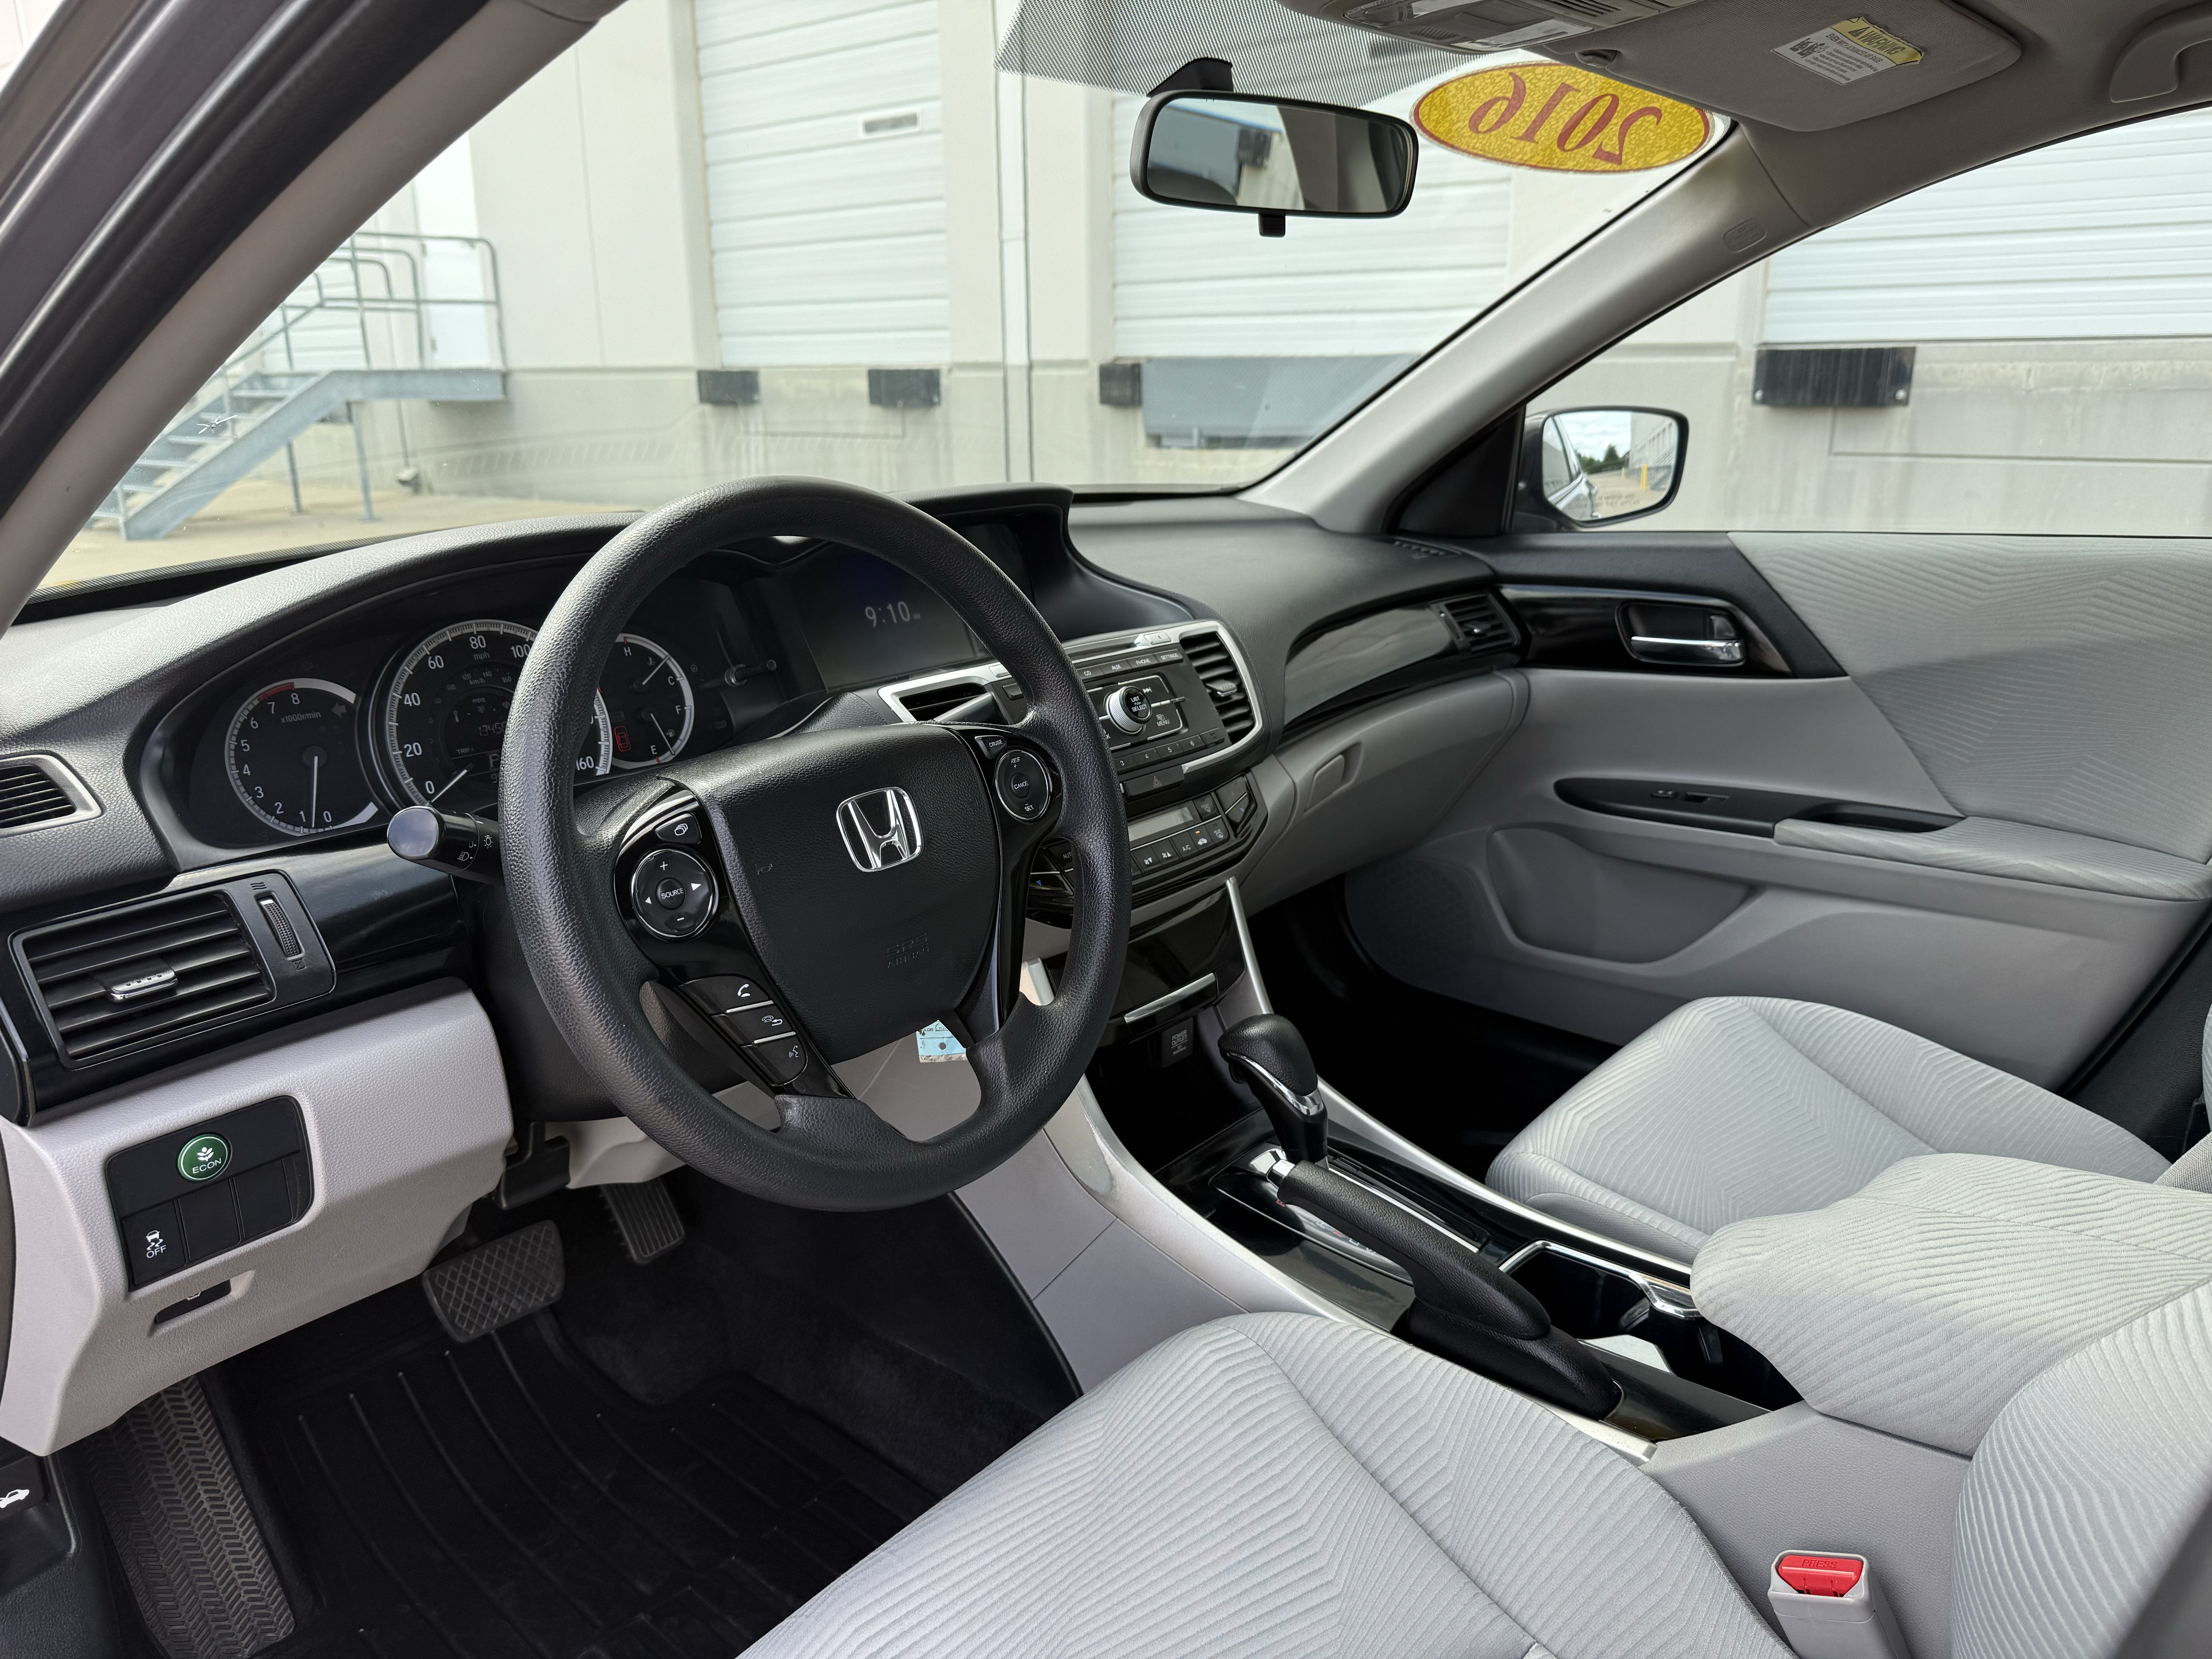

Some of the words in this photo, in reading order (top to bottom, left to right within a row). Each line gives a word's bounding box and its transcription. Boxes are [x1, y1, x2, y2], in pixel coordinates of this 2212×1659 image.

[1858, 31, 1906, 55] WARNING
[865, 601, 910, 627] 9:10
[469, 635, 486, 649] 80
[473, 651, 490, 660] mph
[511, 644, 531, 658] 100
[624, 647, 632, 656] H
[428, 655, 444, 670] 60
[668, 676, 675, 685] C
[291, 692, 300, 704] 8
[404, 692, 421, 706] 40
[267, 702, 275, 714] 7
[675, 705, 681, 714] F
[1132, 704, 1147, 712] SELECT
[251, 717, 258, 729] 6
[241, 740, 250, 751] 5
[404, 742, 422, 757] 20
[651, 745, 658, 755] E
[243, 764, 251, 775] 4
[576, 756, 594, 771] 160
[254, 786, 264, 798] 3
[425, 780, 435, 794] 0
[275, 802, 284, 814] 2
[299, 811, 306, 822] 1
[323, 811, 332, 823] 0
[661, 888, 684, 899] SOURCE
[1172, 1029, 1187, 1041] POWER
[1172, 1034, 1187, 1046] OUTLET
[192, 1158, 222, 1174] ECON
[146, 1245, 166, 1258] OFF
[1802, 1559, 1838, 1568] PRESS
